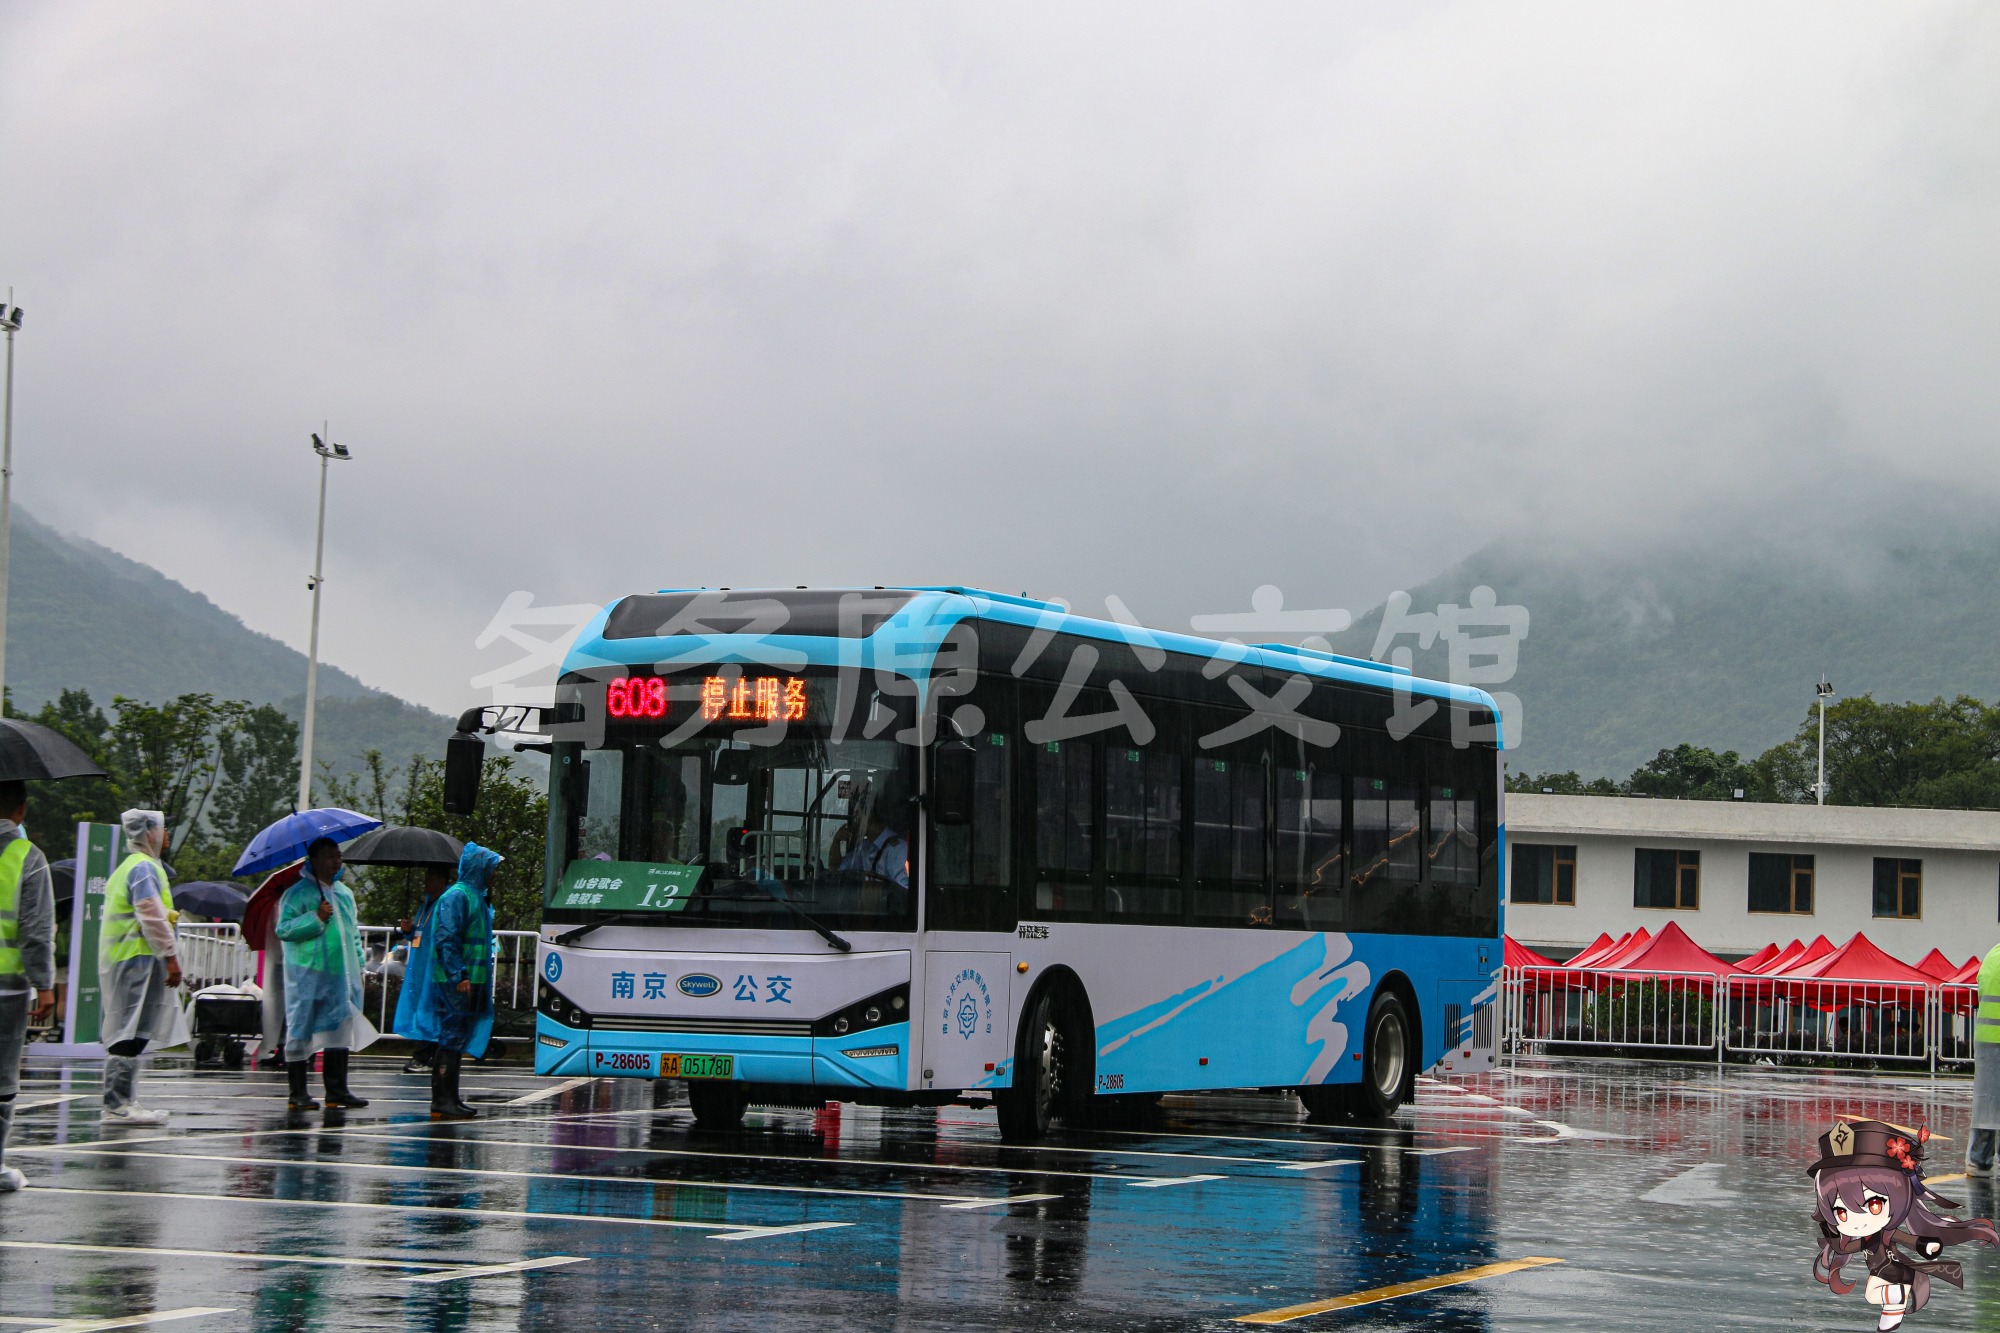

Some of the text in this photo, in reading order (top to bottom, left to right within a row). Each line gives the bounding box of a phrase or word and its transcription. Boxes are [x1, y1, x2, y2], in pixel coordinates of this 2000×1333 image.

[608, 676, 806, 719] 608 停止服务
[637, 884, 679, 908] 13
[611, 971, 793, 1004] 南京 Skywell 公交
[595, 1052, 651, 1070] P-28605
